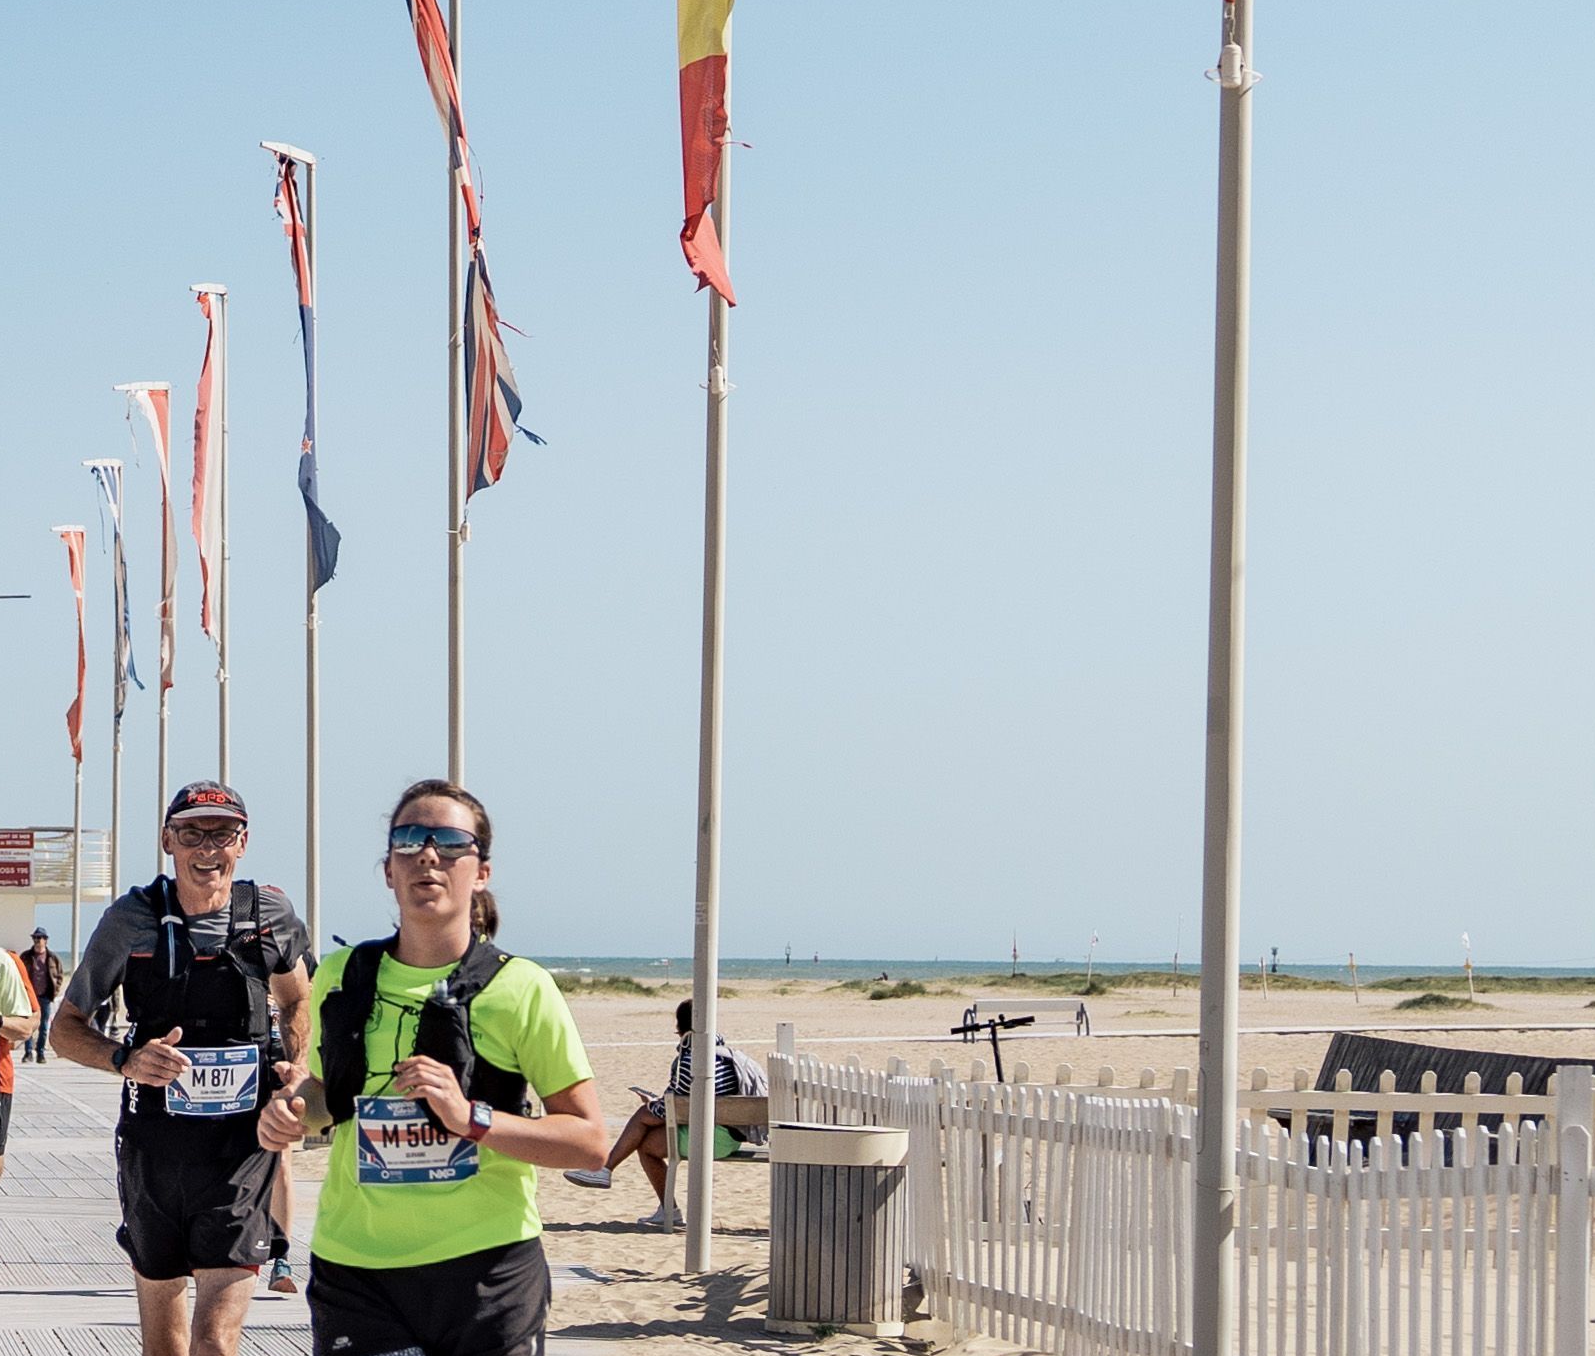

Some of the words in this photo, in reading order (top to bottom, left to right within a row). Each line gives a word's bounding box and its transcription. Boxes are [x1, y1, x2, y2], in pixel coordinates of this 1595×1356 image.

[192, 1068, 206, 1087] M
[211, 1068, 234, 1087] 871
[382, 1124, 400, 1148] M
[428, 1167, 456, 1180] NXP
